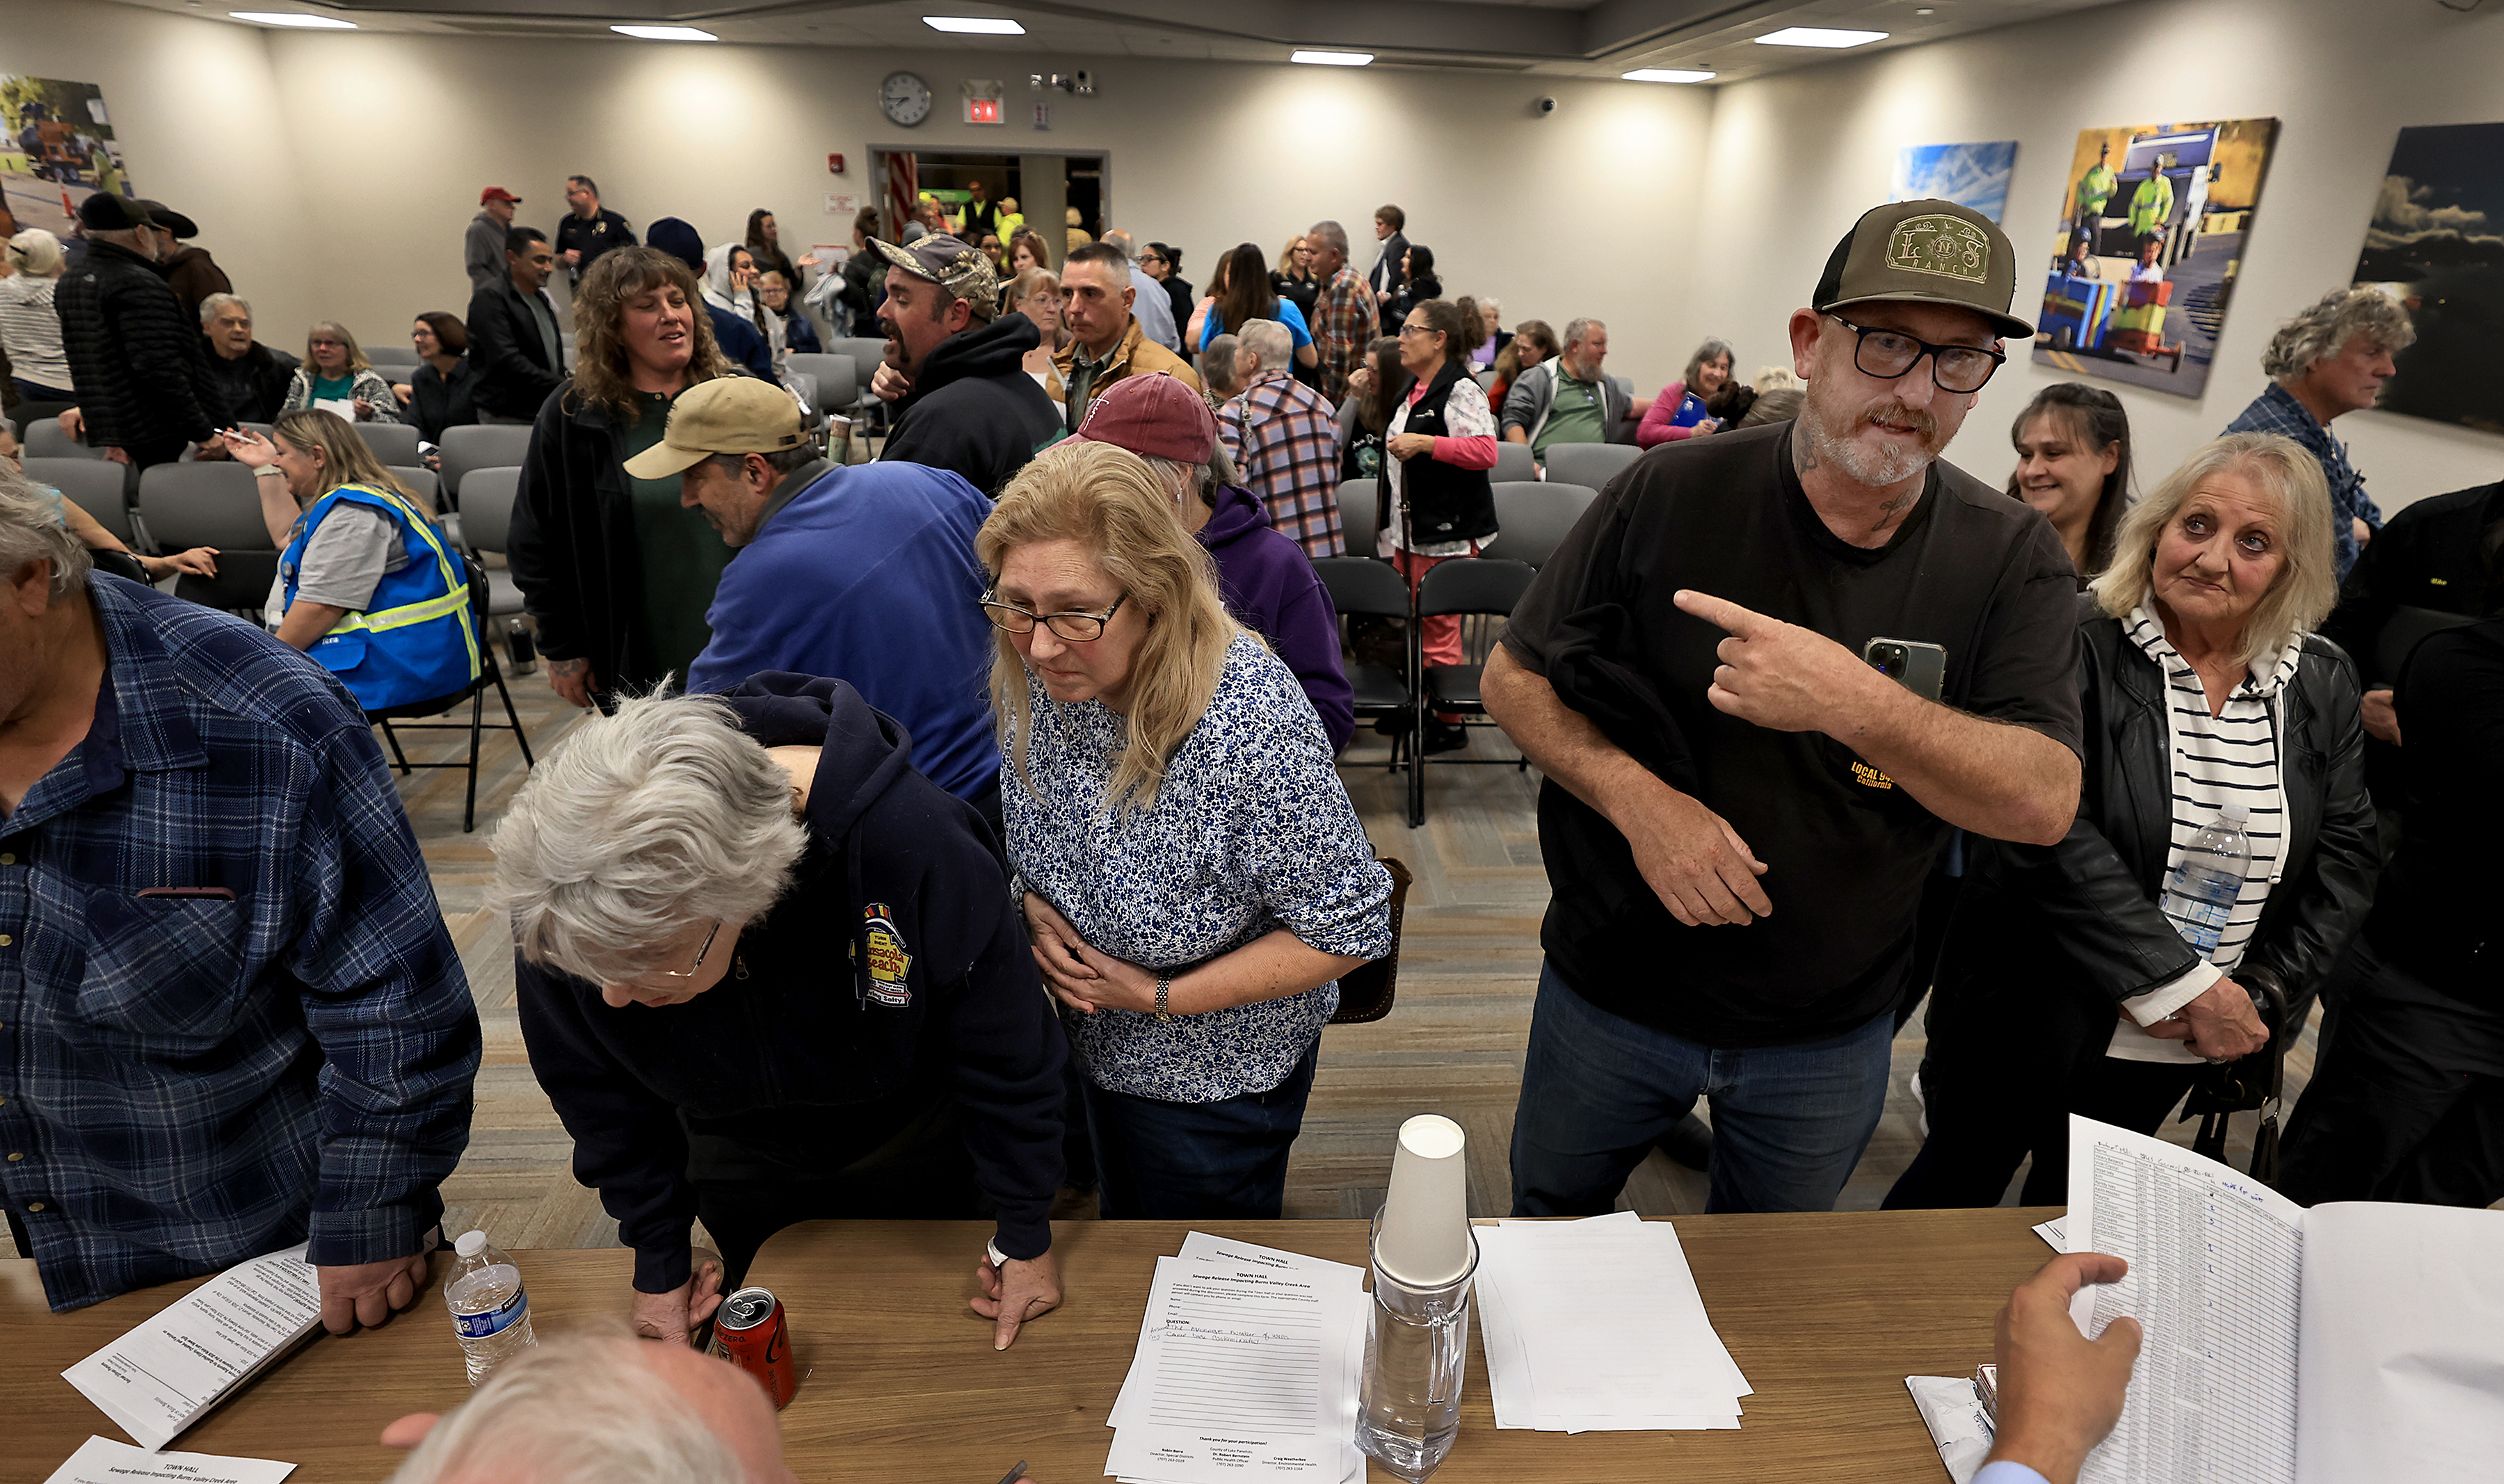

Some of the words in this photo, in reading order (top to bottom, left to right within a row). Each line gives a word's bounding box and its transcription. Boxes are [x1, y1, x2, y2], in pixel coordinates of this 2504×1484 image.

[1912, 259, 1968, 275] RANCH
[1851, 761, 1878, 780] LOCAL
[1879, 772, 1895, 782] 94
[868, 947, 904, 963] nsacola
[869, 990, 882, 1001] ving
[1252, 1259, 1274, 1267] Impacting
[504, 1284, 523, 1309] KIRKLA
